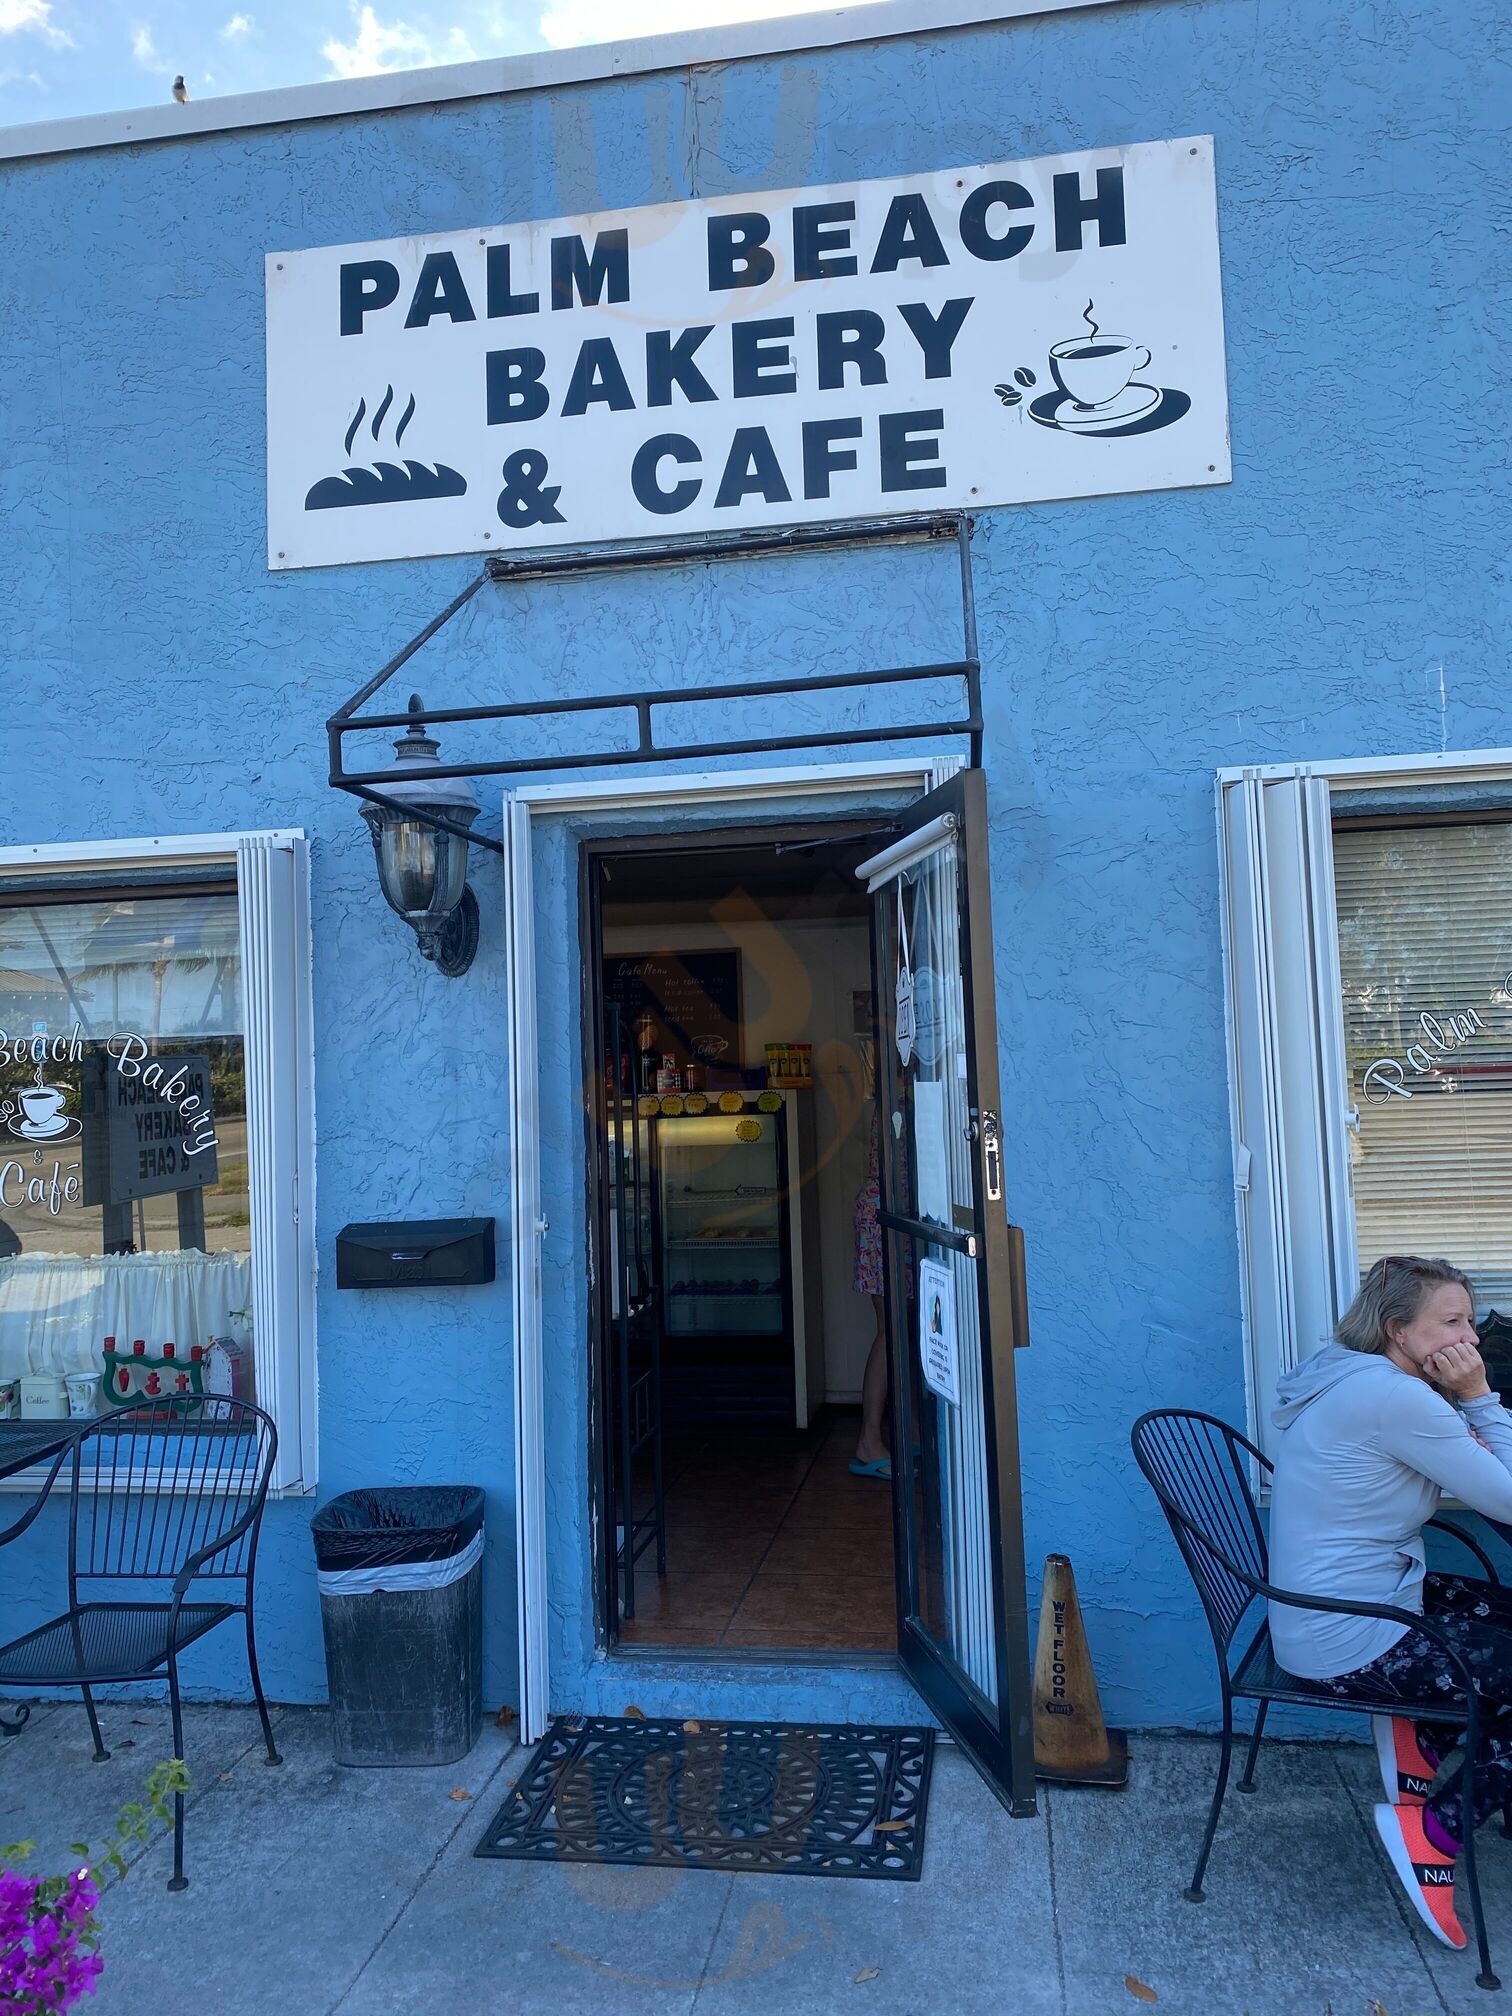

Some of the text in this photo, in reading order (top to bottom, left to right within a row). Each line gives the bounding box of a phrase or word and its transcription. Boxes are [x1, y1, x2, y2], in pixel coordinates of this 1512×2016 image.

[340, 166, 1128, 337] PALM BEACH
[485, 297, 975, 427] BAKERY
[496, 409, 947, 530] & CAFE
[106, 1032, 219, 1156] Bakery
[1363, 1007, 1488, 1105] Palm
[0, 1161, 79, 1215] Café
[1052, 1600, 1066, 1635] WET
[1052, 1639, 1066, 1698] FLOOR
